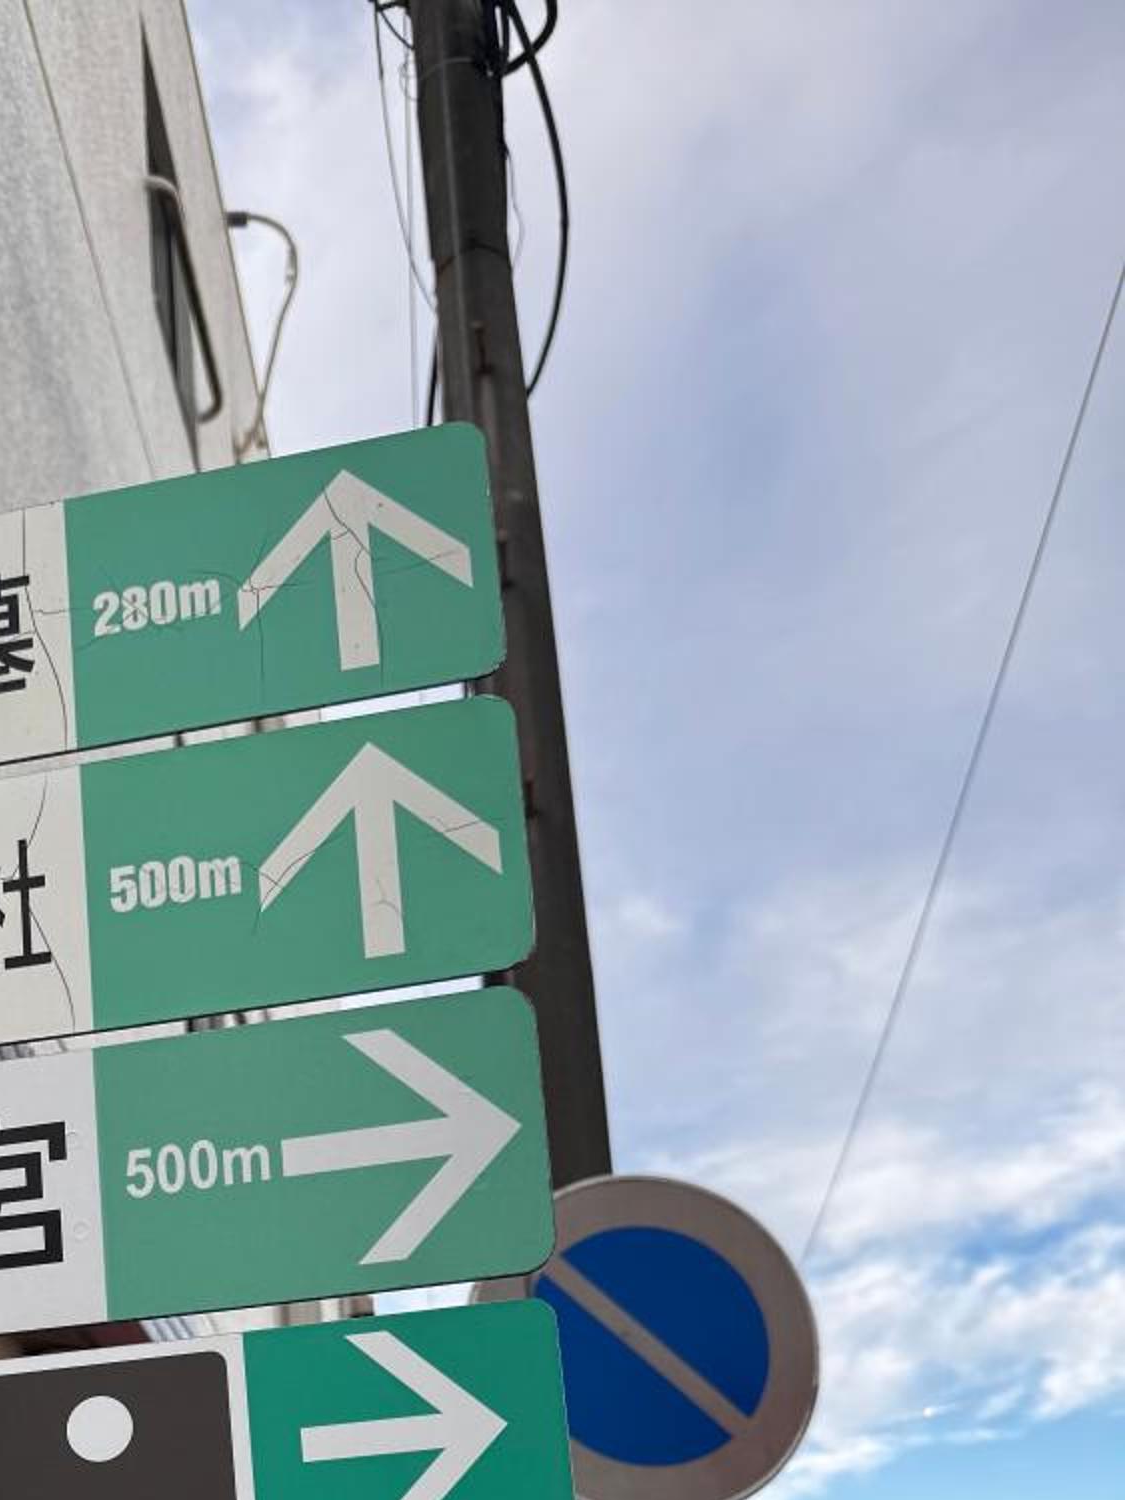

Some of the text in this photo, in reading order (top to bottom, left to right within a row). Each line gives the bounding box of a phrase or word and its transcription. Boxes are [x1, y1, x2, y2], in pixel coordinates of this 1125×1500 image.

[93, 579, 222, 637] 280m
[110, 855, 242, 913] 500m
[126, 1139, 271, 1198] 500m
